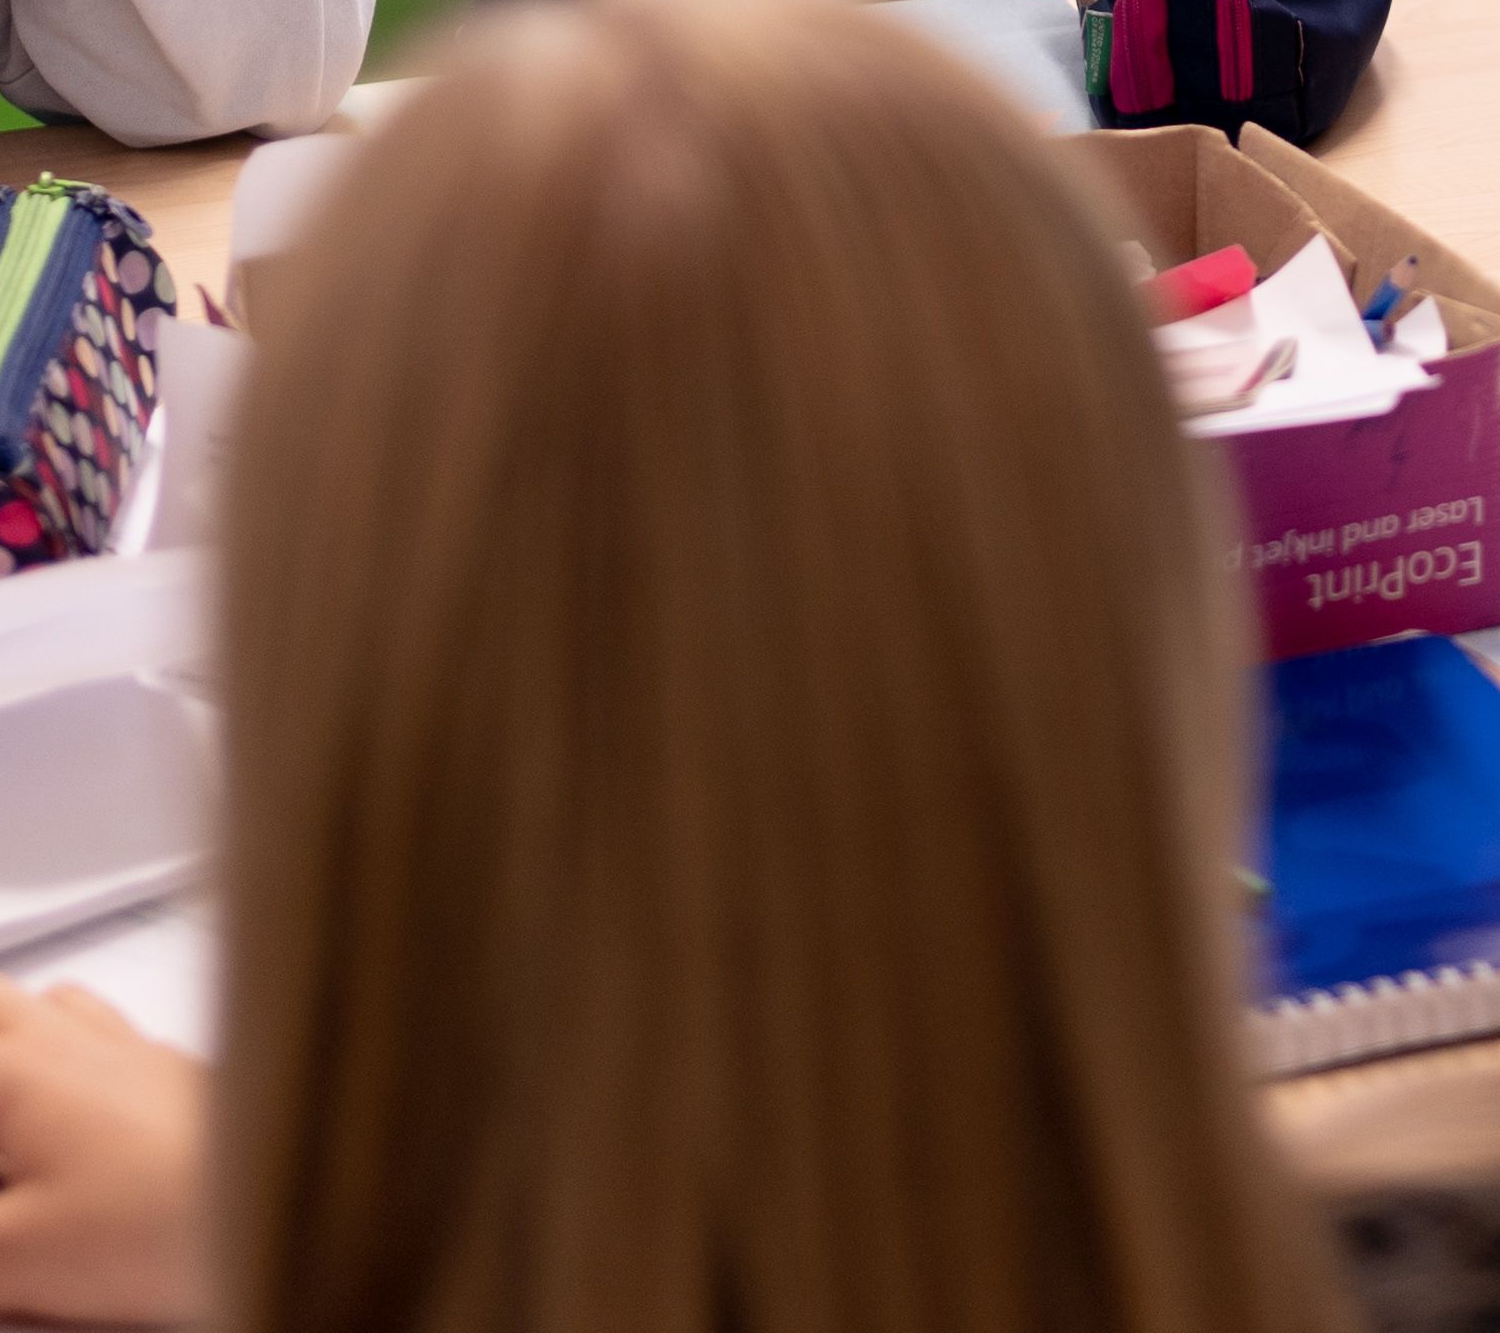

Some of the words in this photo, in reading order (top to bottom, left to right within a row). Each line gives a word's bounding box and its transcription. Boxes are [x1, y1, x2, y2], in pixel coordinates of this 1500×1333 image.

[1341, 512, 1401, 554] and
[1407, 496, 1485, 532] Laser
[1251, 526, 1335, 571] inkjet
[1307, 541, 1484, 612] EcoPrint
